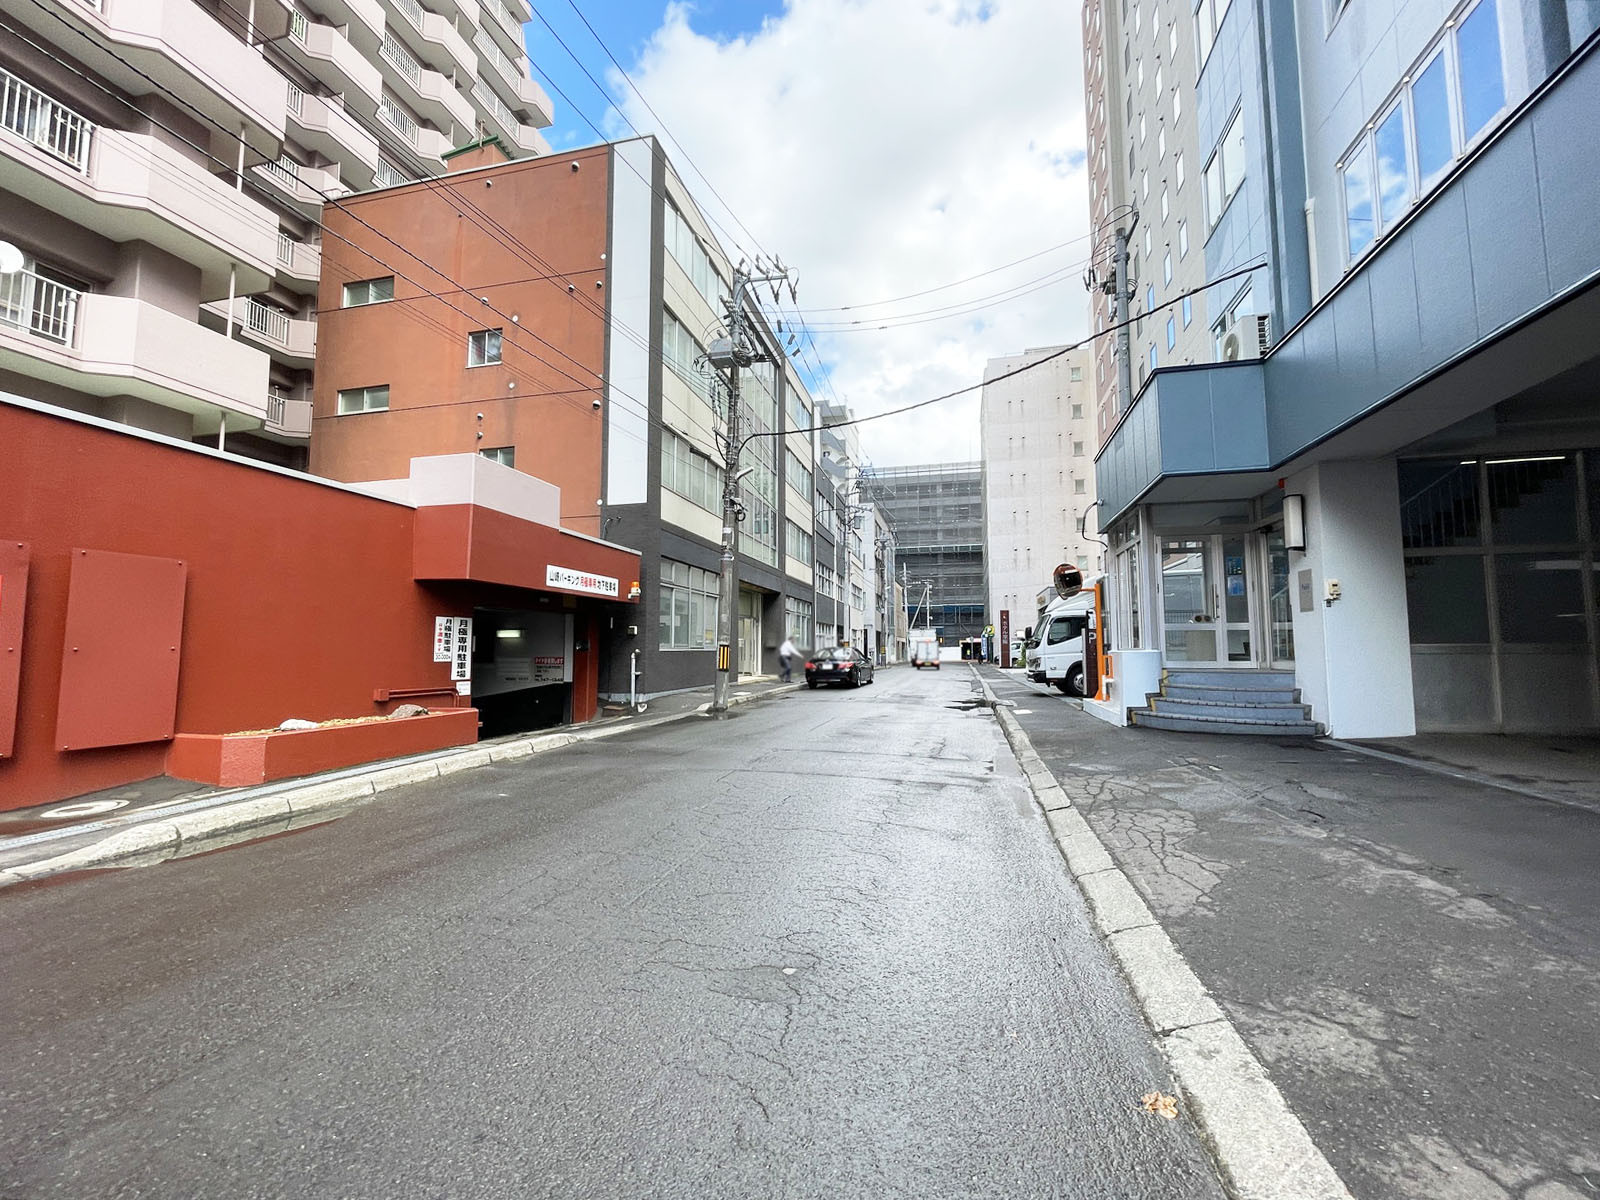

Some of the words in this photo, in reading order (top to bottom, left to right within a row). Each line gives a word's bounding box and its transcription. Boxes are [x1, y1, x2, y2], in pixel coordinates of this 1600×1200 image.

[443, 618, 452, 652] 月極駐車場
[456, 619, 468, 678] 月極専用駐車場
